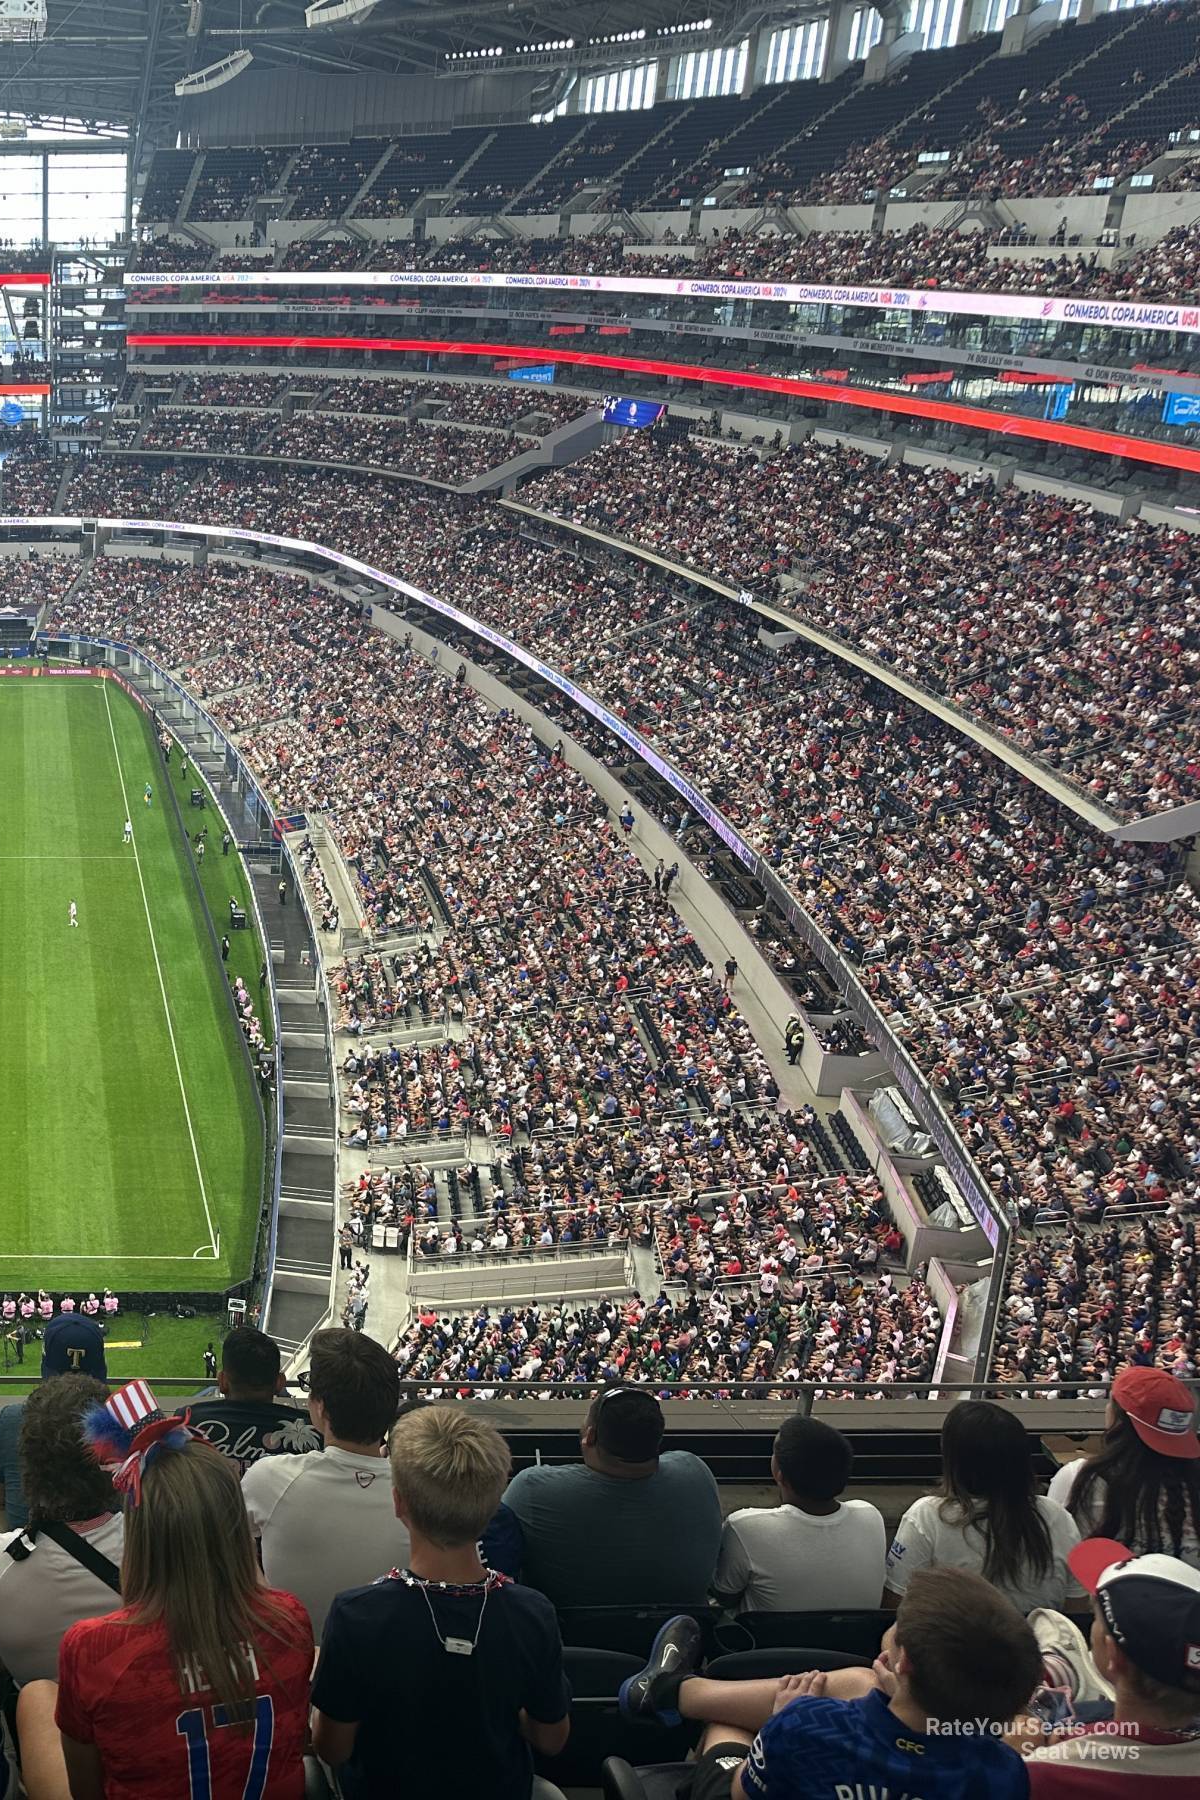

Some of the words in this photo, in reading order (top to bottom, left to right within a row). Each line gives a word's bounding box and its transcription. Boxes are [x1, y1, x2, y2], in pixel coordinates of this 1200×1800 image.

[690, 283, 720, 293] CONMEBOL
[720, 284, 737, 295] COPA
[737, 285, 761, 296] AMERICA
[762, 286, 772, 296] USA
[799, 287, 834, 300] CONMEBOL
[834, 289, 851, 301] COPA
[850, 290, 879, 303] AMERICA
[880, 292, 892, 304] USA
[1063, 302, 1111, 321] CONMEBOL
[1111, 305, 1135, 323] COPA
[1135, 308, 1179, 326] AMERICA
[1181, 310, 1199, 328] USA
[975, 354, 987, 364] BOB
[988, 355, 1003, 366] LILLY
[1095, 369, 1109, 379] DON
[1110, 371, 1138, 384] PERKINS
[66, 1348, 86, 1369] T
[175, 1694, 275, 1800] 17
[895, 1738, 926, 1755] CFC
